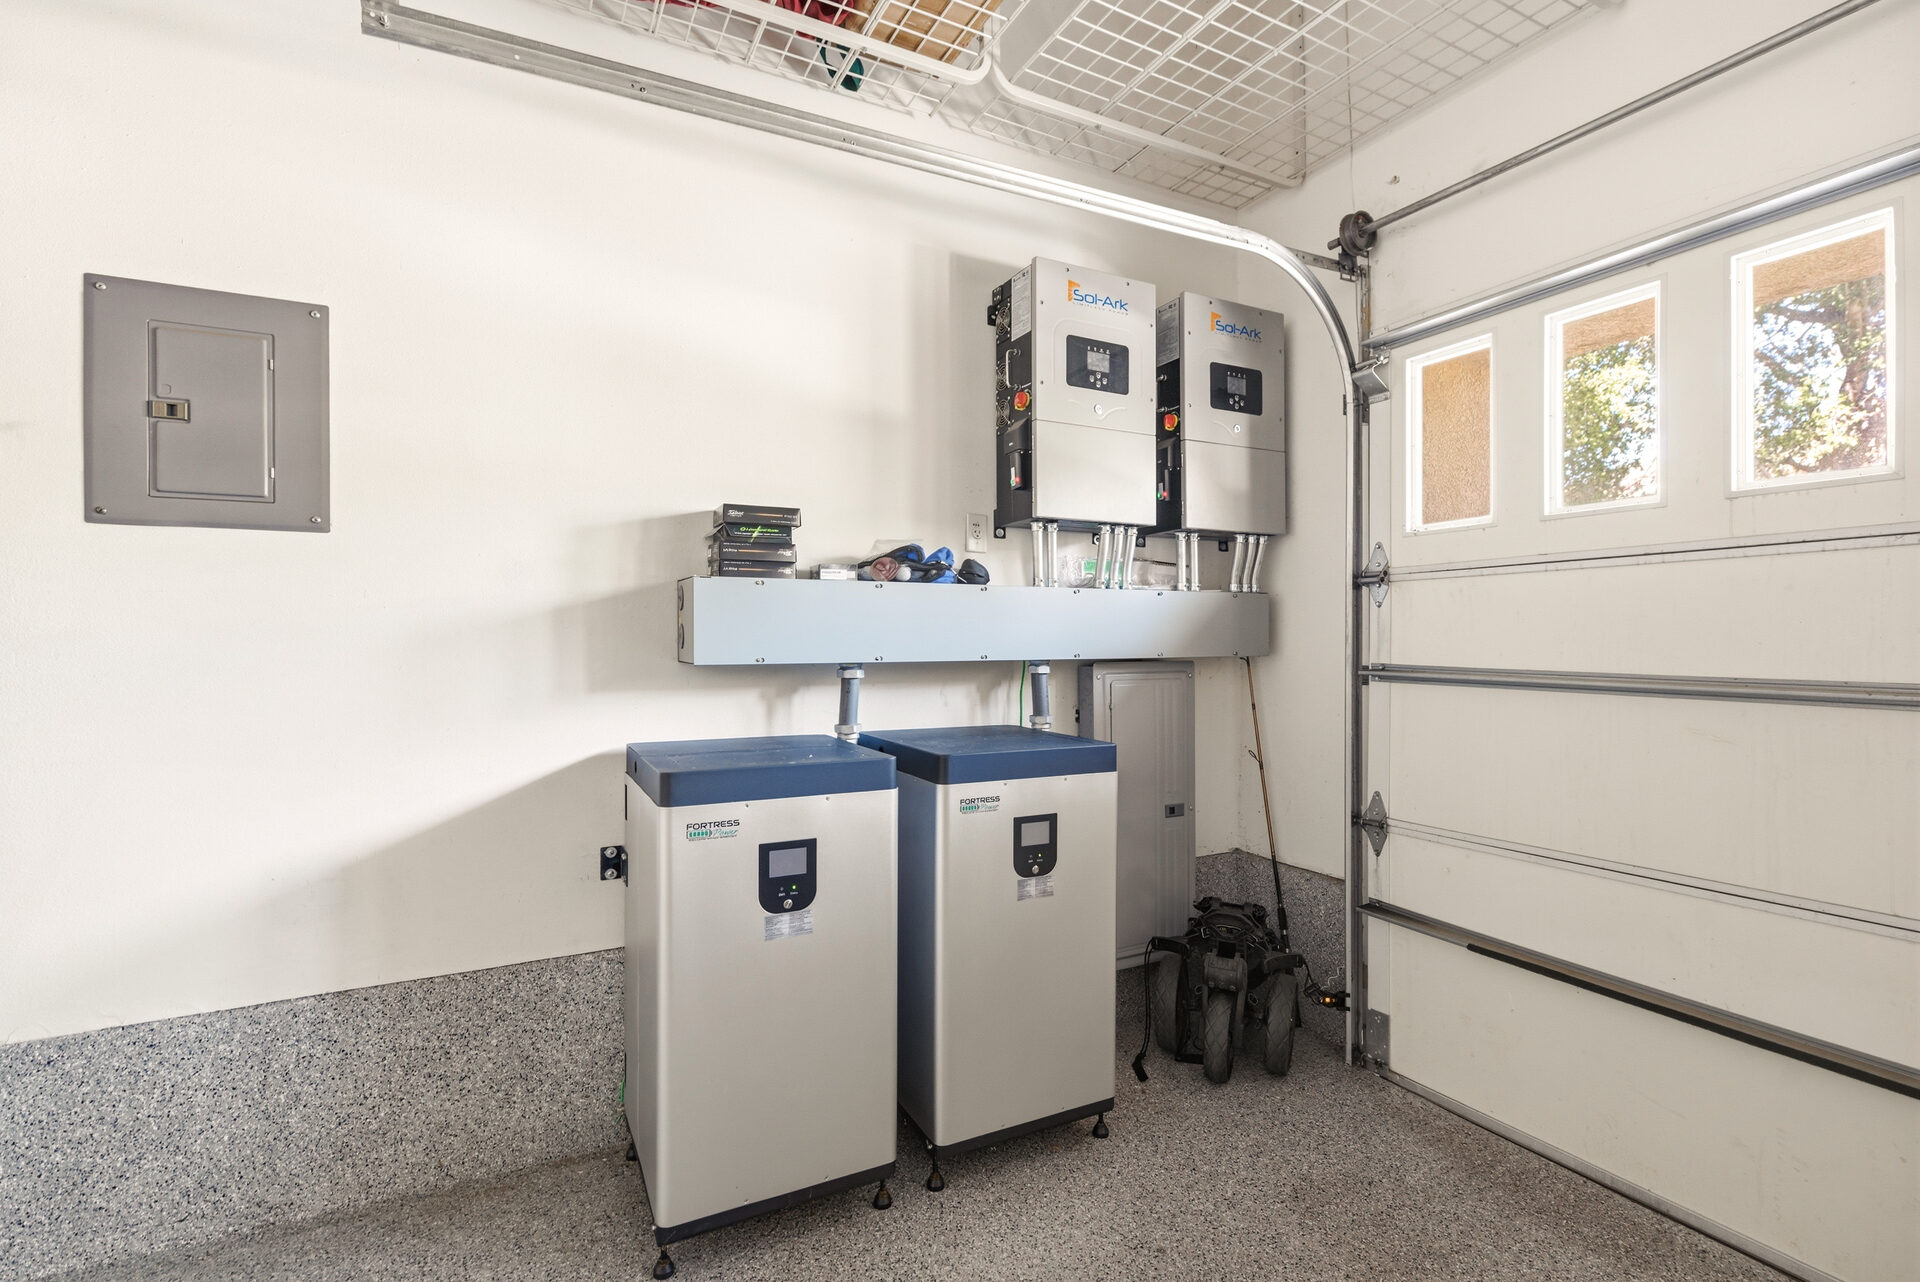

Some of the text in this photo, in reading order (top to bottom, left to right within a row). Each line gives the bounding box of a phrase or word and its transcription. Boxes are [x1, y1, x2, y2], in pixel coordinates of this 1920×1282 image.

[1073, 289, 1129, 312] Sol-Ark
[1215, 320, 1262, 340] Sol-Ark
[960, 795, 1001, 805] FORTRESS
[686, 819, 740, 831] FORTRESS
